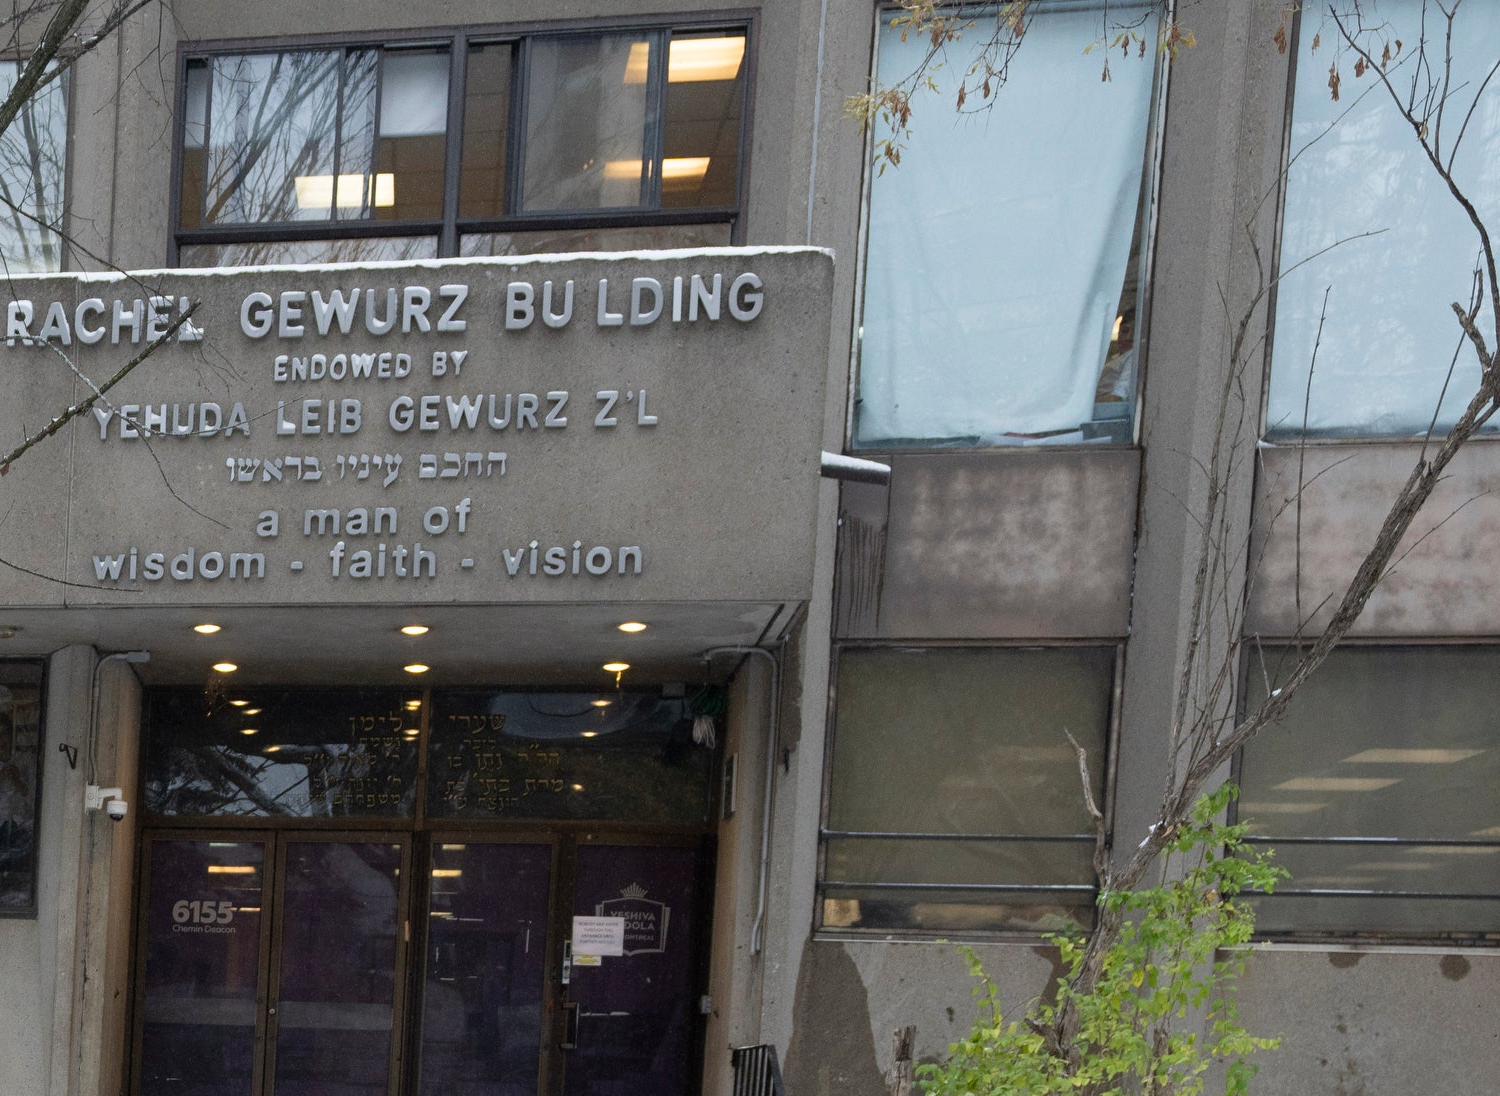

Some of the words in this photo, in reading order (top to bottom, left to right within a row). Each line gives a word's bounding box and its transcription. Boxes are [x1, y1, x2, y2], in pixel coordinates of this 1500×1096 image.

[6, 295, 204, 347] RACHEL
[240, 284, 469, 339] GEWURZ
[273, 352, 412, 382] ENDOWED
[432, 350, 468, 377] BY
[92, 402, 252, 440] YEHUDA
[276, 398, 363, 436] LEIB
[389, 391, 569, 432] GEWURZ
[595, 389, 659, 426] Z'L
[226, 456, 322, 483] בראשו
[337, 453, 403, 489] עיניו
[419, 452, 508, 479] החכם
[256, 510, 279, 538] a
[303, 506, 398, 536] man
[423, 497, 472, 535] of
[92, 546, 266, 581] wisdom
[329, 541, 437, 578] faith
[502, 540, 643, 576] vision
[172, 899, 234, 925] 6155
[624, 921, 655, 931] DOLA
[172, 924, 204, 934] Chemin
[204, 925, 236, 934] Deacon
